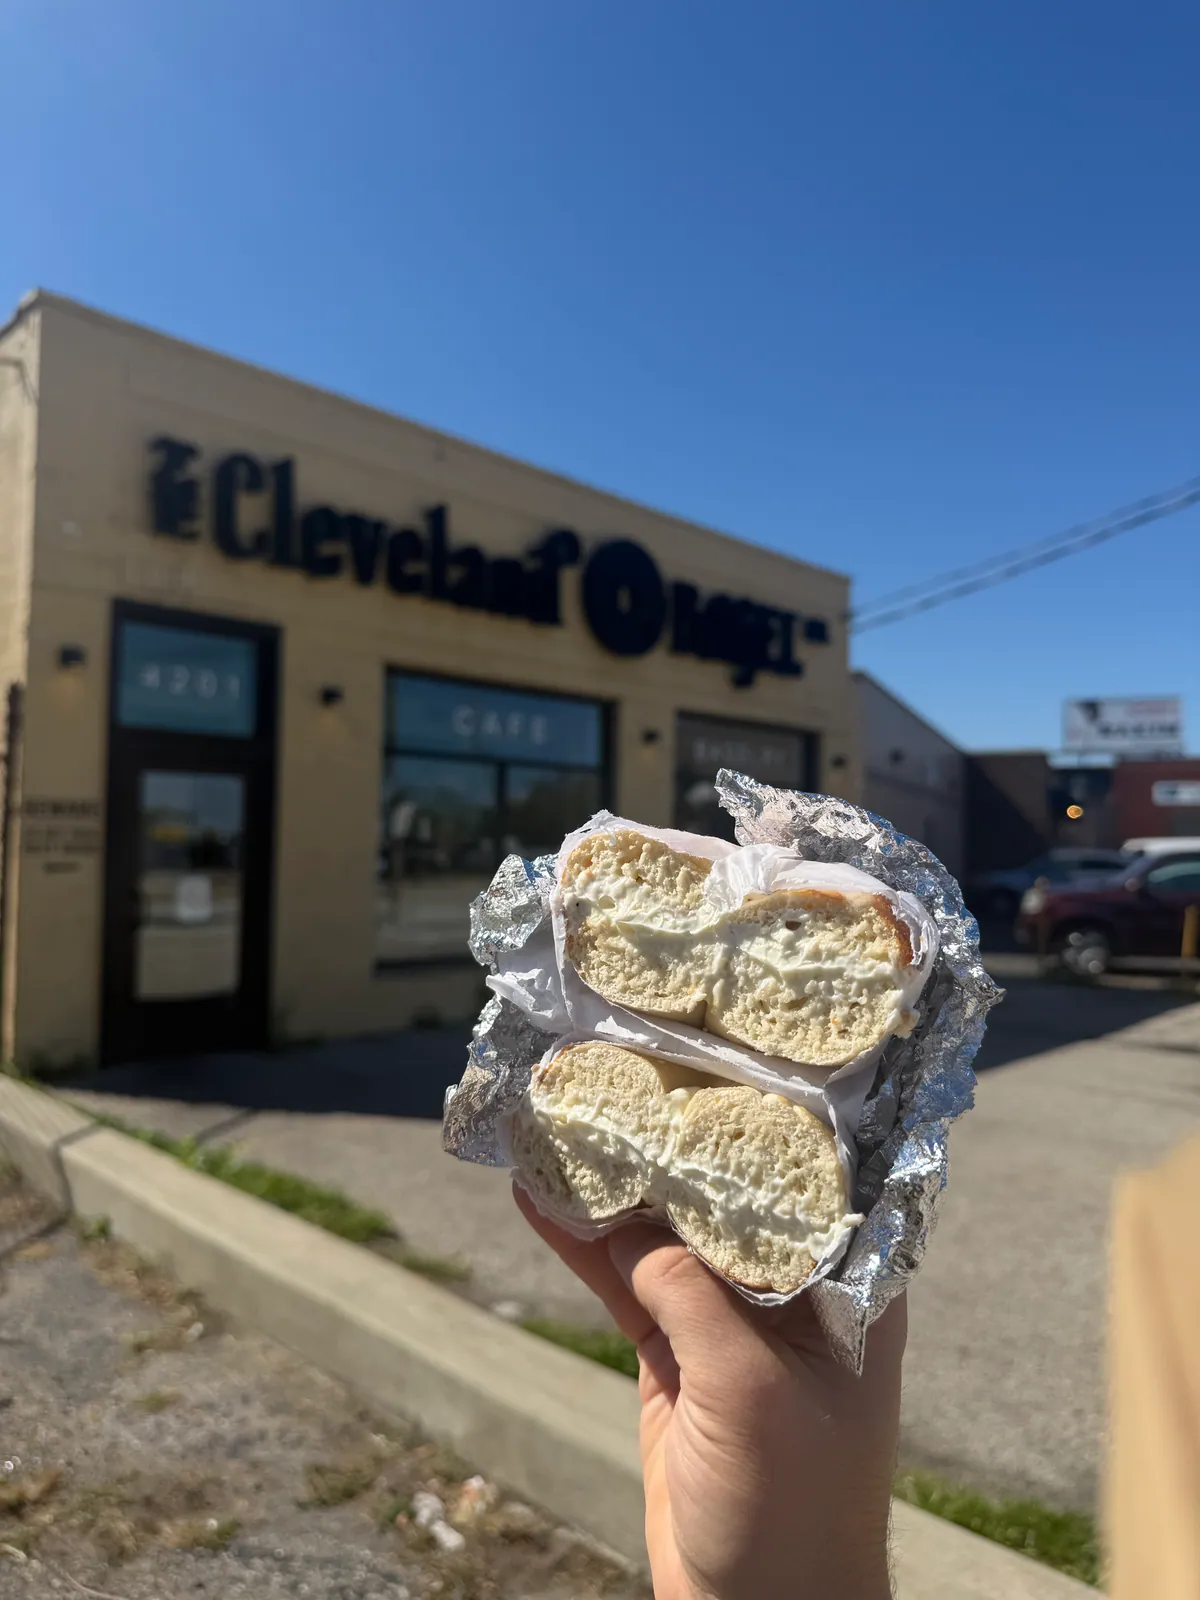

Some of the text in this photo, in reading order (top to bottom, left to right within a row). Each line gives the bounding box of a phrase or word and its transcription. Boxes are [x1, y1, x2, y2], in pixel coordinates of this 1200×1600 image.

[212, 452, 580, 626] Cleveland
[138, 663, 241, 699] 4201
[452, 704, 548, 745] CAFE
